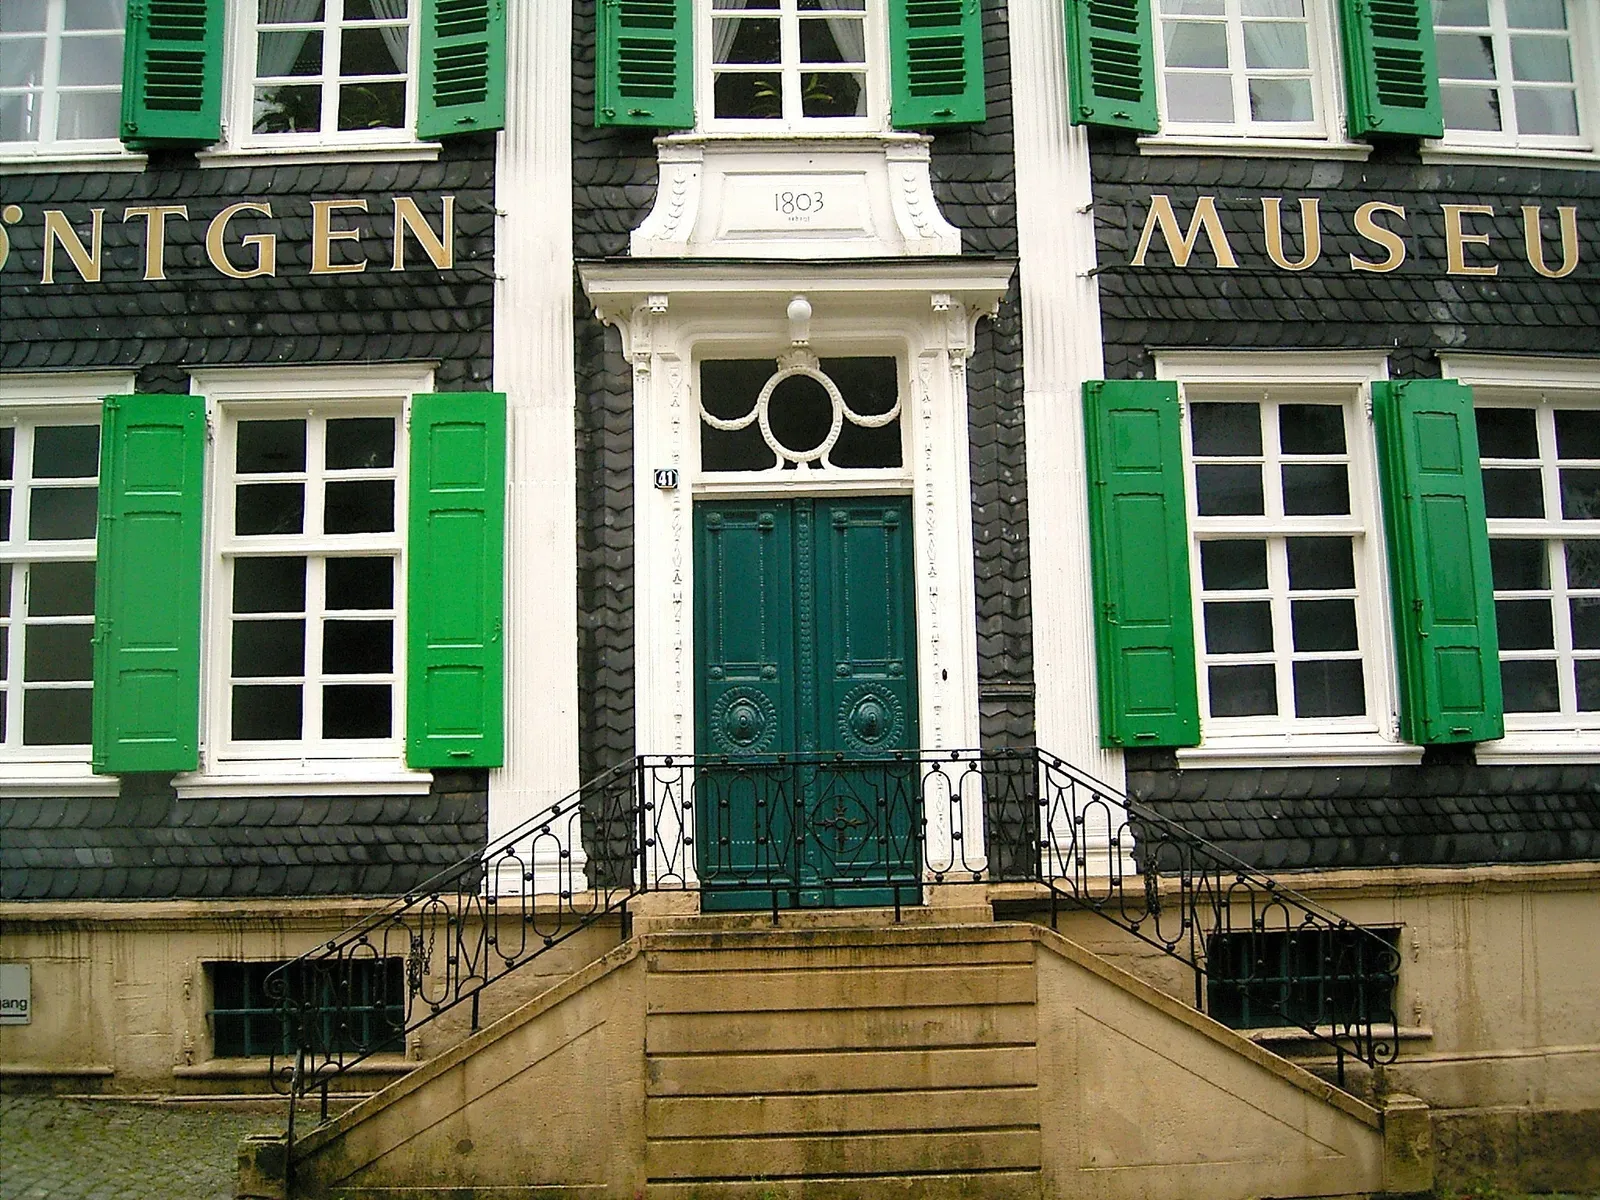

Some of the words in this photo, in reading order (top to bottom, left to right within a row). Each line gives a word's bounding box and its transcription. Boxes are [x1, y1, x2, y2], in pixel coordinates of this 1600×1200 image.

[775, 191, 824, 214] 1803
[0, 195, 456, 284] NTGEN
[1130, 194, 1580, 278] MUSEU
[658, 471, 673, 486] 41
[0, 998, 28, 1012] ang
